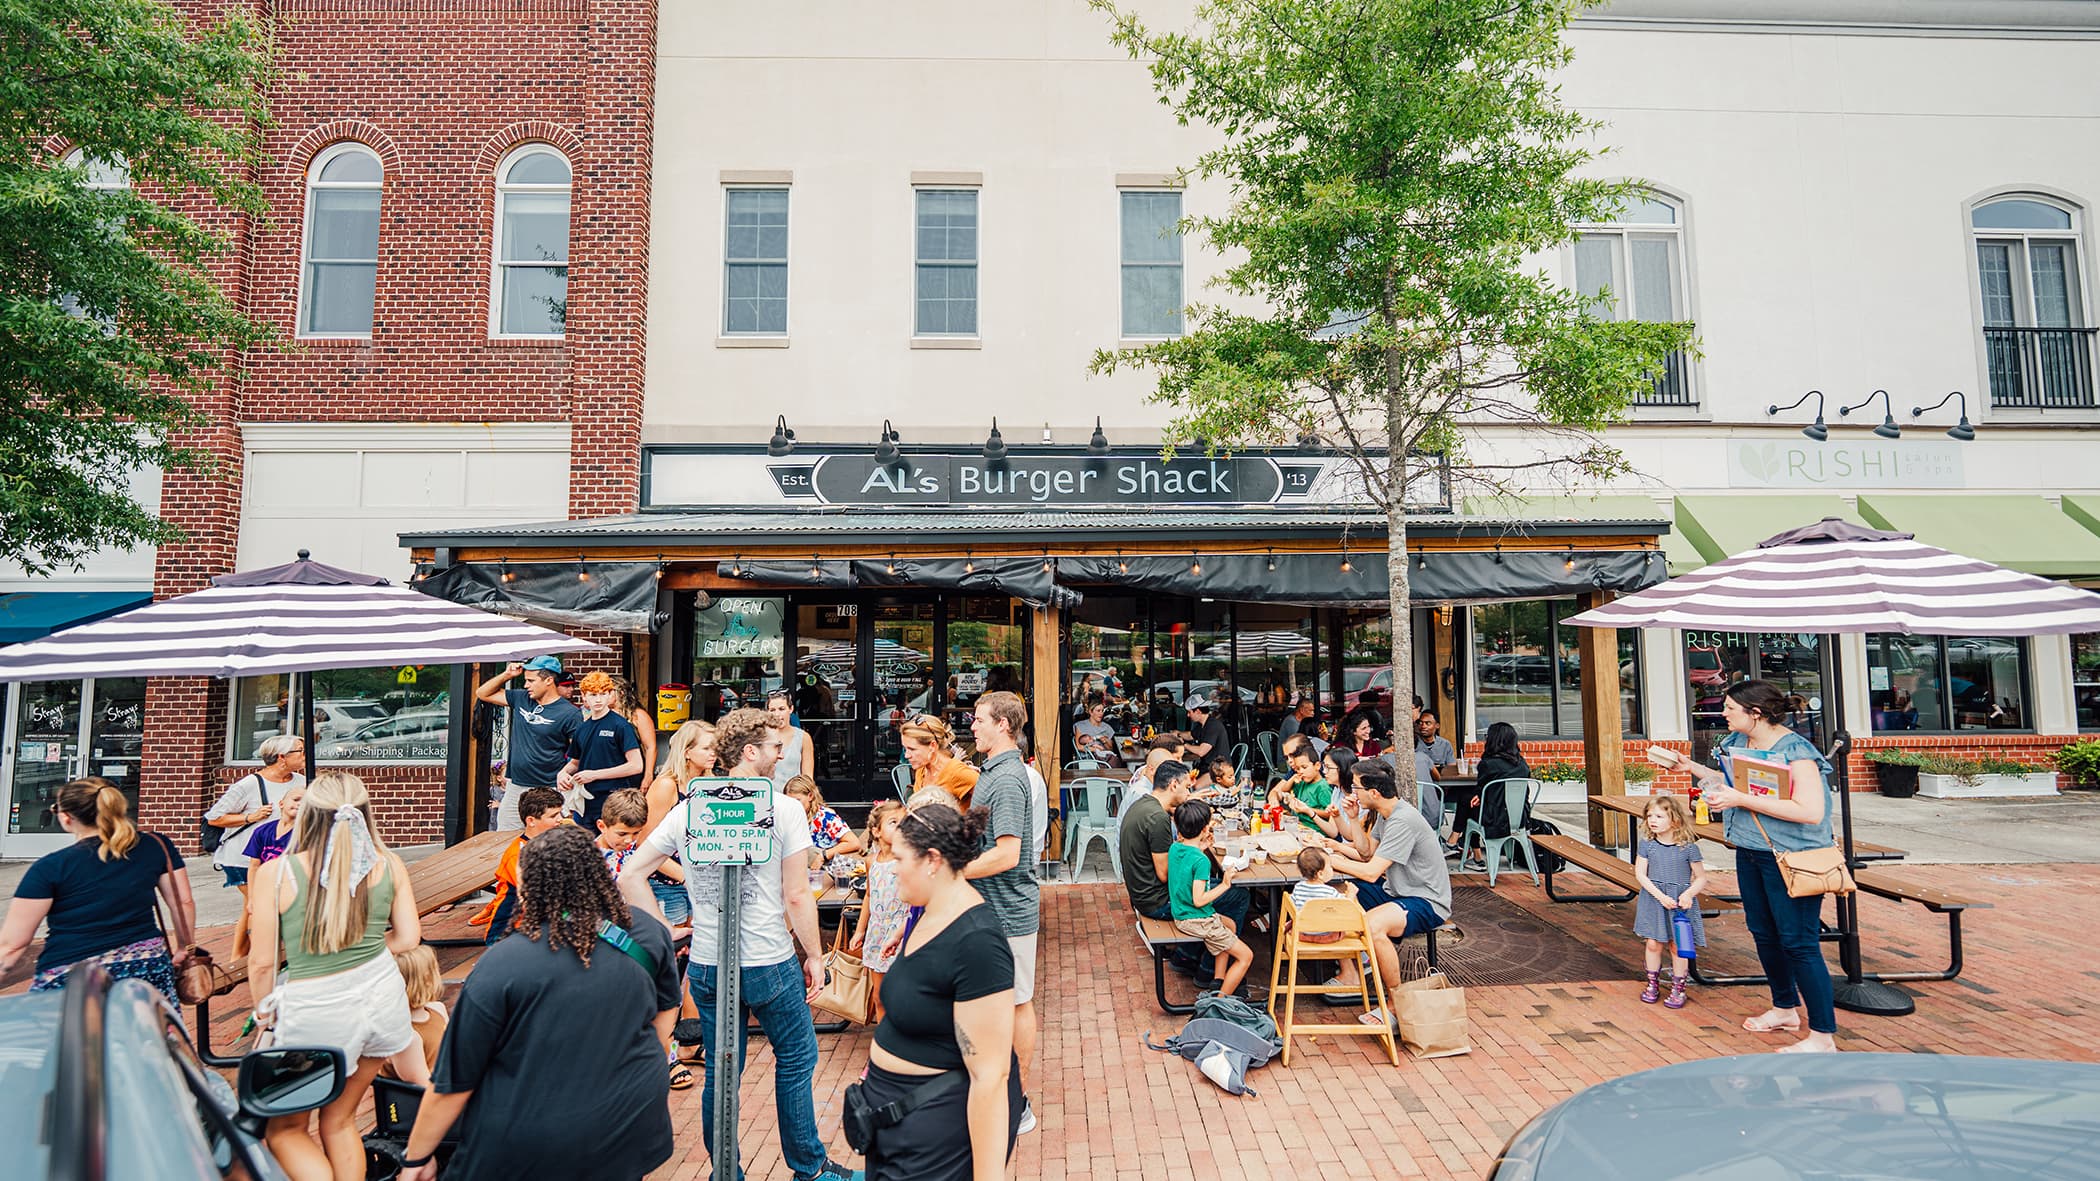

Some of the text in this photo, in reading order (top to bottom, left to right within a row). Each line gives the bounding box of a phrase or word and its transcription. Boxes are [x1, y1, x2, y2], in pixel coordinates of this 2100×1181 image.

[1787, 450, 1899, 482] RISHI
[781, 474, 809, 486] Est.
[860, 461, 1232, 501] AL's Burger Shack
[720, 598, 763, 615] OPEN
[839, 605, 857, 616] 708
[703, 639, 781, 656] BURGERS
[1686, 632, 1748, 651] RISHI
[1774, 641, 1796, 649] spa
[33, 704, 65, 722] Strays
[107, 704, 139, 722] Strays
[361, 746, 404, 758] Shipping
[411, 746, 448, 758] Packagi
[723, 810, 745, 818] HOUR
[723, 829, 737, 838] TO
[697, 843, 724, 852] MON.
